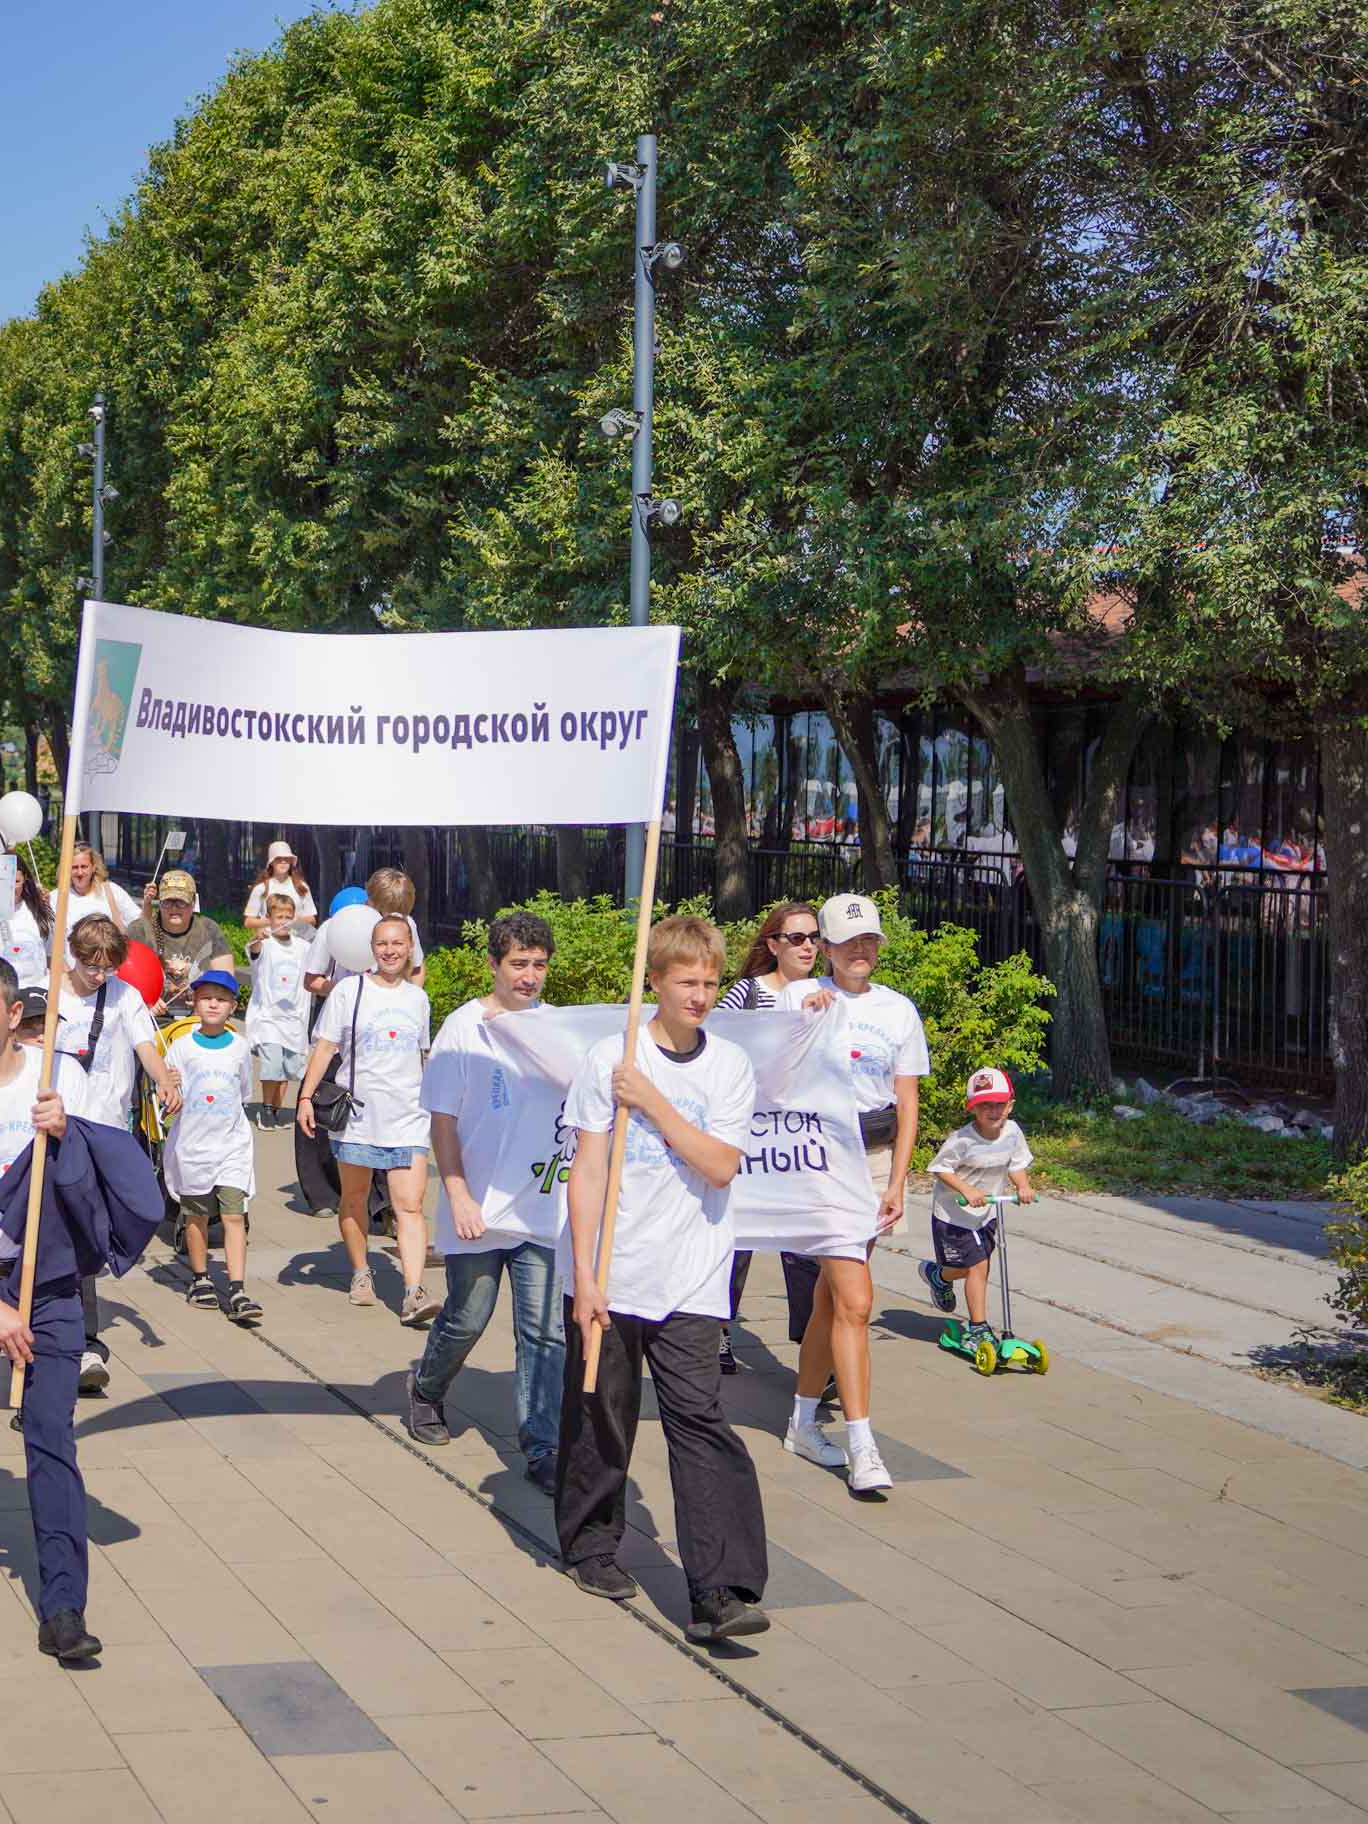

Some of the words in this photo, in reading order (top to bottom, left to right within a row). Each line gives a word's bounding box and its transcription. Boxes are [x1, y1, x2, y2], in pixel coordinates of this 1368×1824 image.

[136, 688, 365, 745] Владивостокский
[377, 703, 549, 753] городской
[560, 710, 649, 750] округ
[750, 1110, 822, 1137] СТОК
[738, 1139, 830, 1175] НЫЙ
